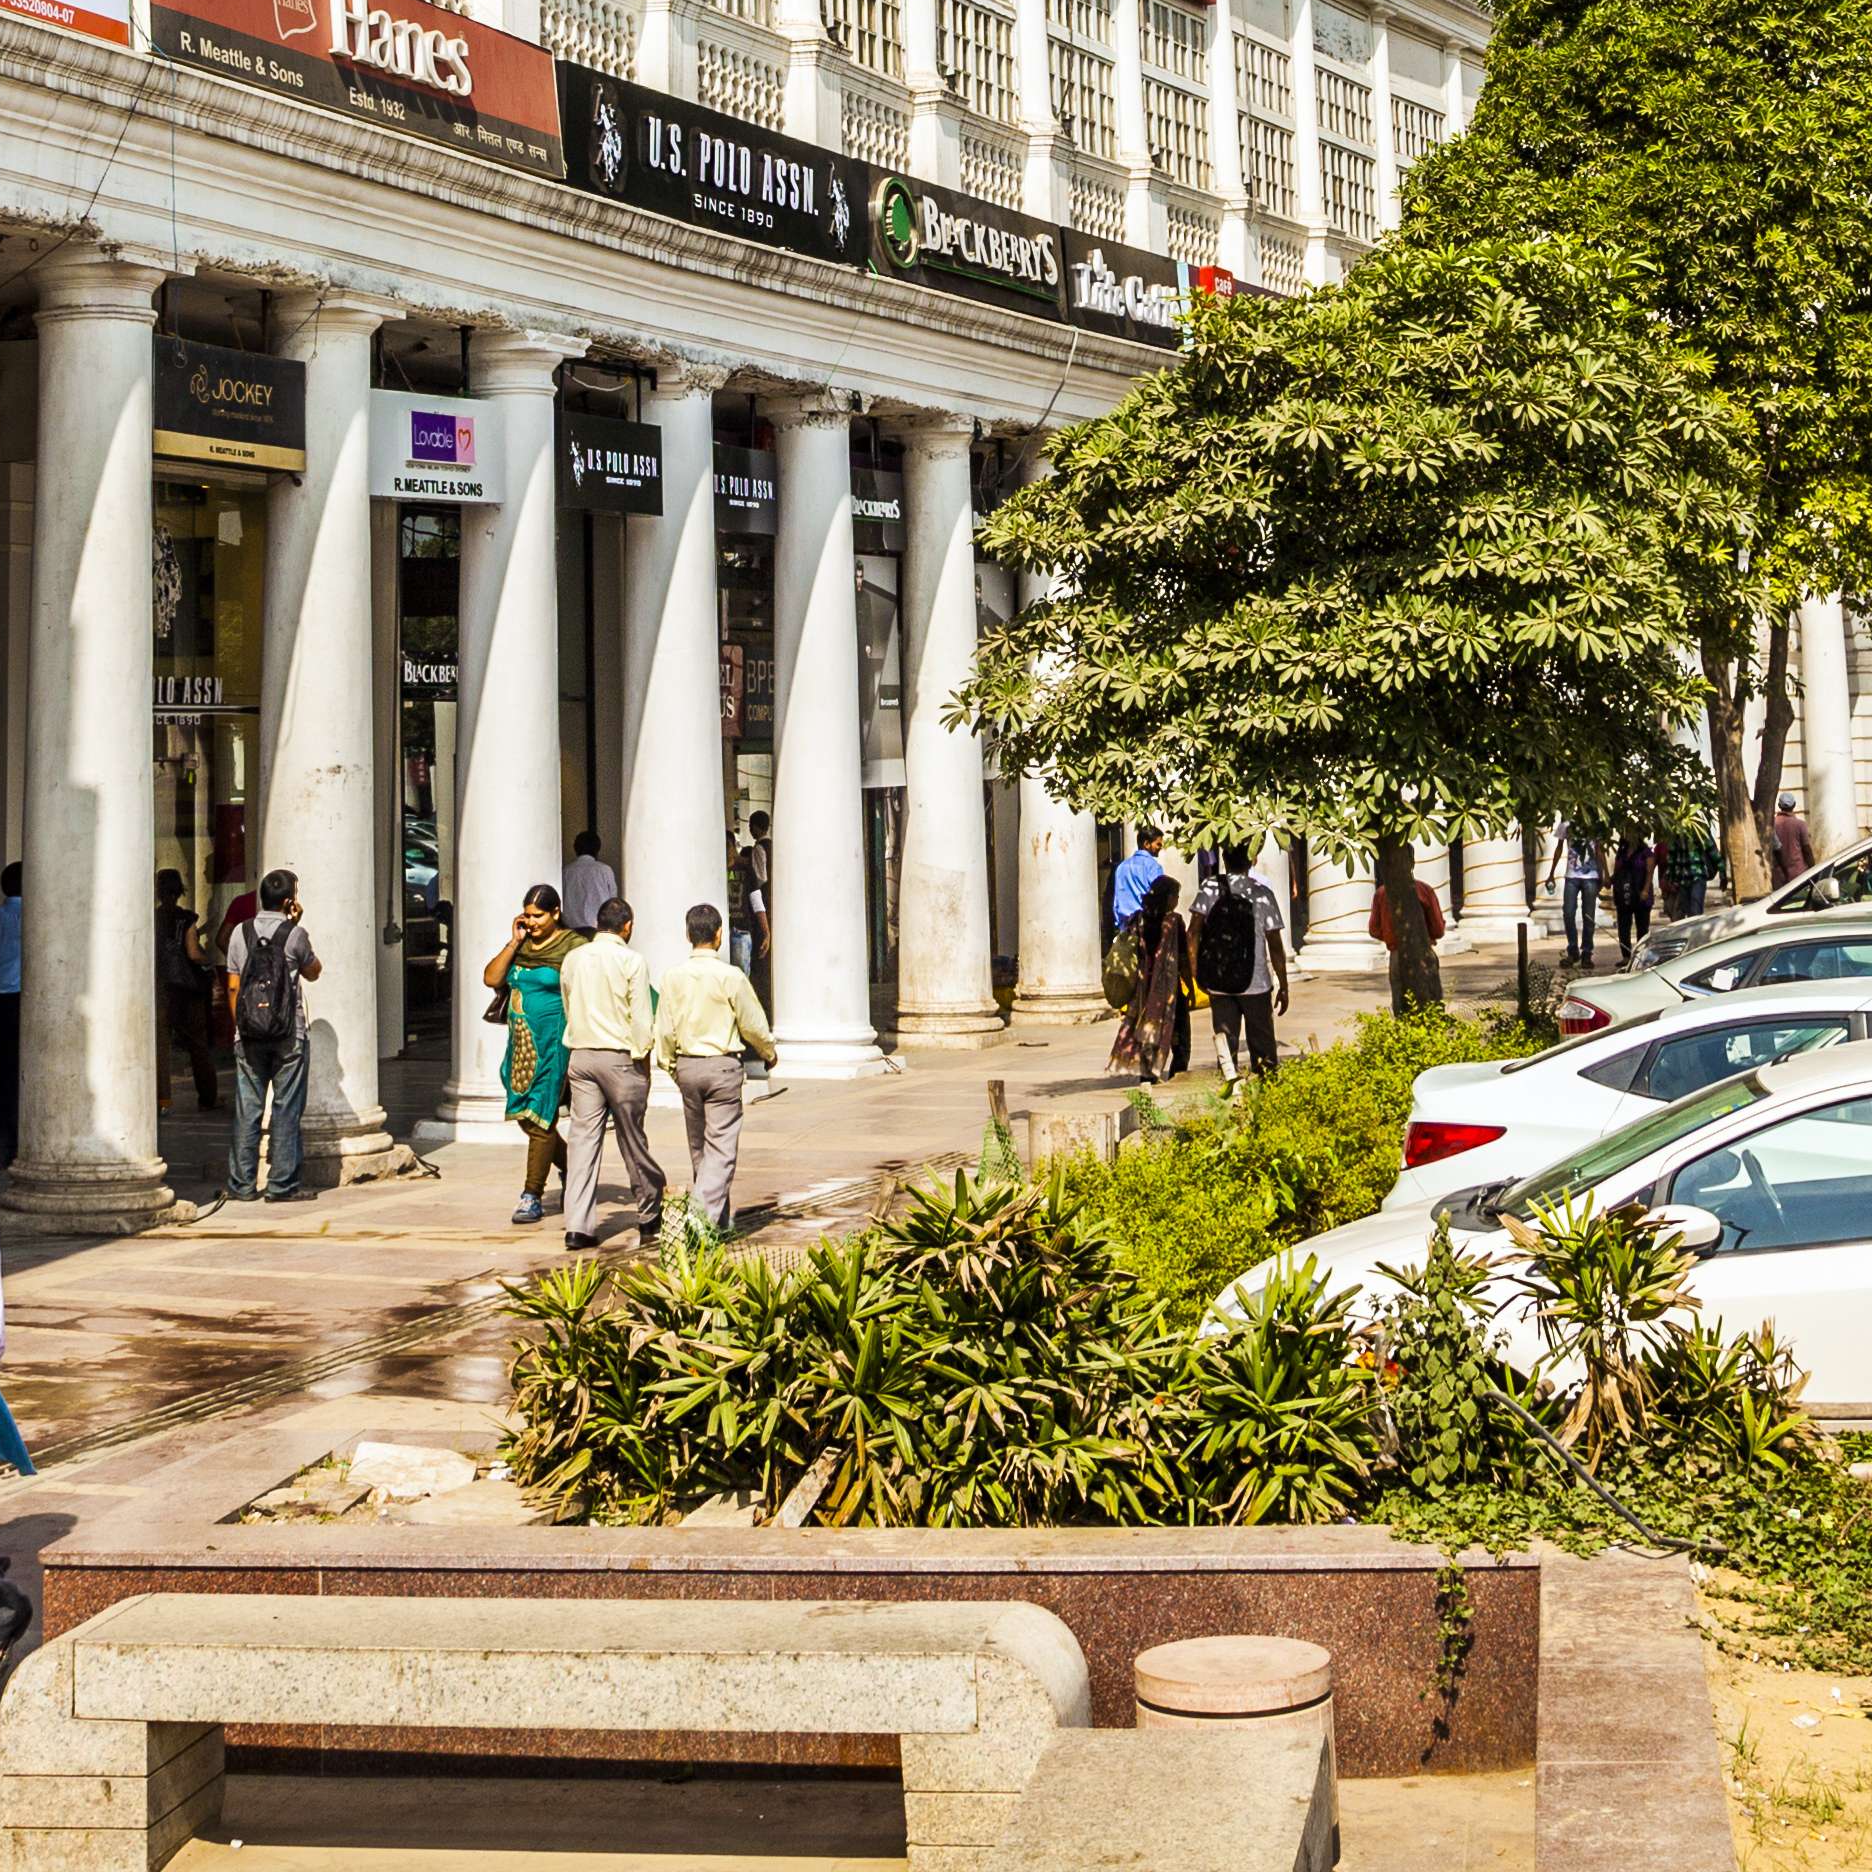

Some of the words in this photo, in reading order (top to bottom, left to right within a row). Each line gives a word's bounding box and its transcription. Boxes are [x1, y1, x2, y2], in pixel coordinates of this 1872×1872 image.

[180, 30, 196, 54] R.
[200, 36, 252, 70] Meattle
[255, 54, 266, 76] &
[269, 58, 305, 88] Sons
[349, 85, 378, 113] Estd.
[380, 95, 407, 122] 1932
[648, 116, 687, 177] U.S.
[700, 132, 751, 196] POLO
[762, 153, 819, 217] ASSN.
[692, 193, 736, 219] SINCE
[741, 206, 774, 229] 1890
[211, 378, 273, 407] JOCKEY
[413, 424, 454, 449] Lovable
[606, 450, 629, 474] POLO
[394, 477, 404, 492] R.
[404, 478, 448, 495] MEATTLE
[449, 481, 456, 495] &
[457, 481, 483, 497] SONS
[729, 475, 749, 497] POLO
[404, 660, 459, 683] BLACKBER
